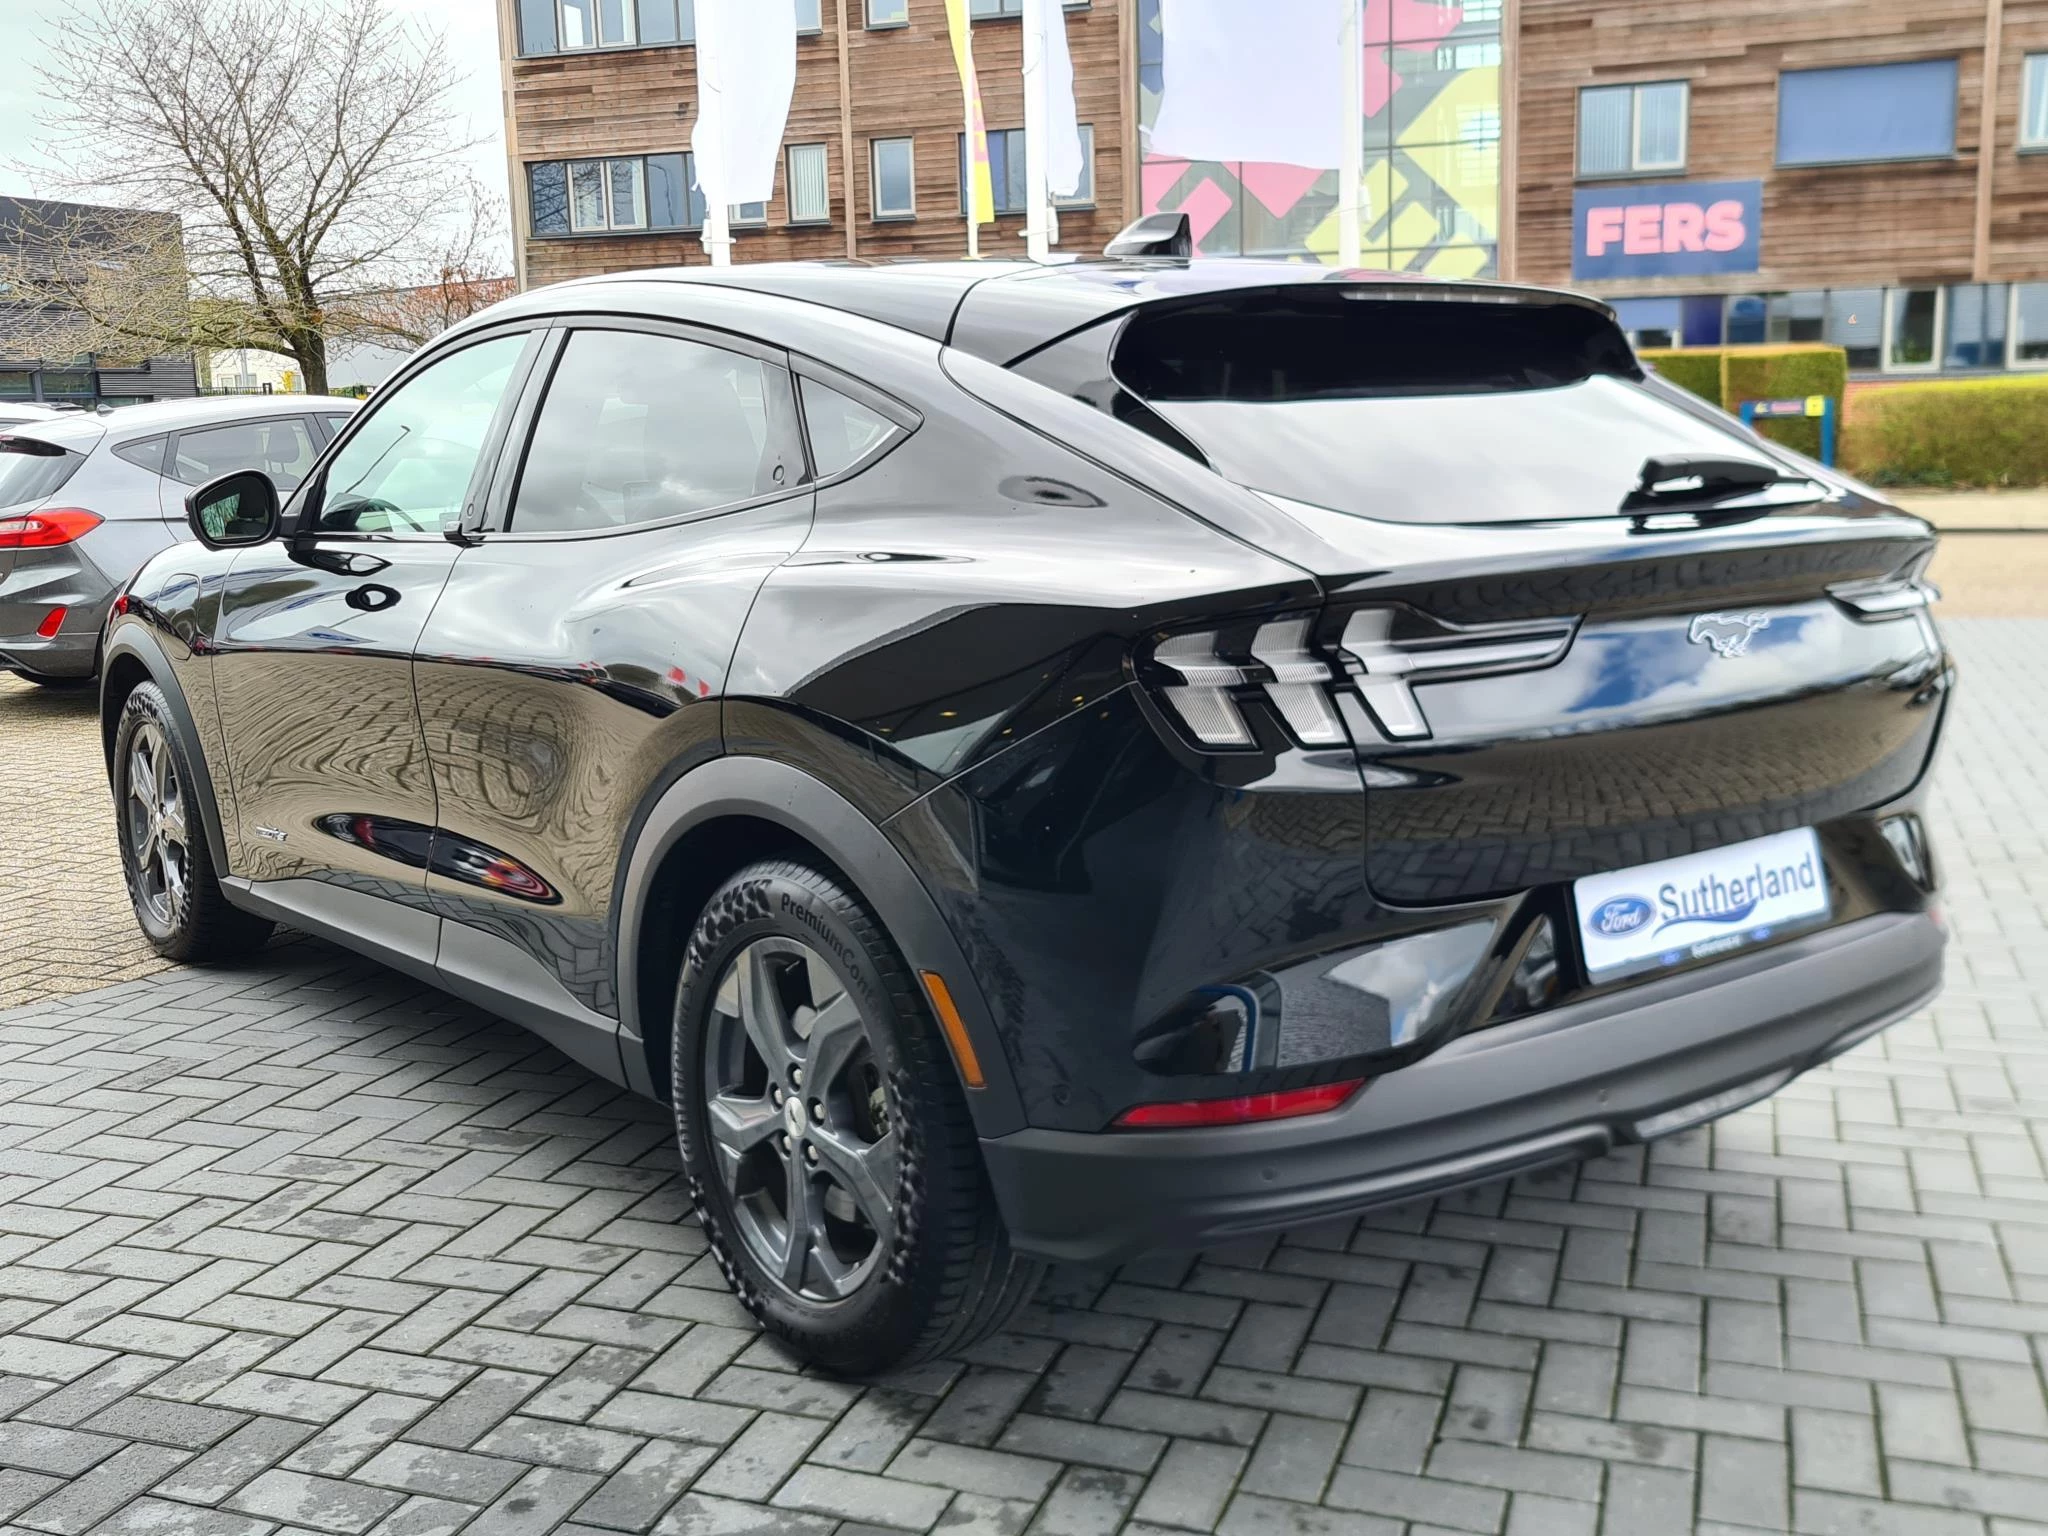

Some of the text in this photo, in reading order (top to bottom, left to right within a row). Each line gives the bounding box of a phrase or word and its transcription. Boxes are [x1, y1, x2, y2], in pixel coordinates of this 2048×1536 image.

[1586, 199, 1746, 257] FERS
[1601, 901, 1642, 932] Ford
[1658, 851, 1816, 921] Sutherland
[780, 892, 878, 1010] PremiumCont
